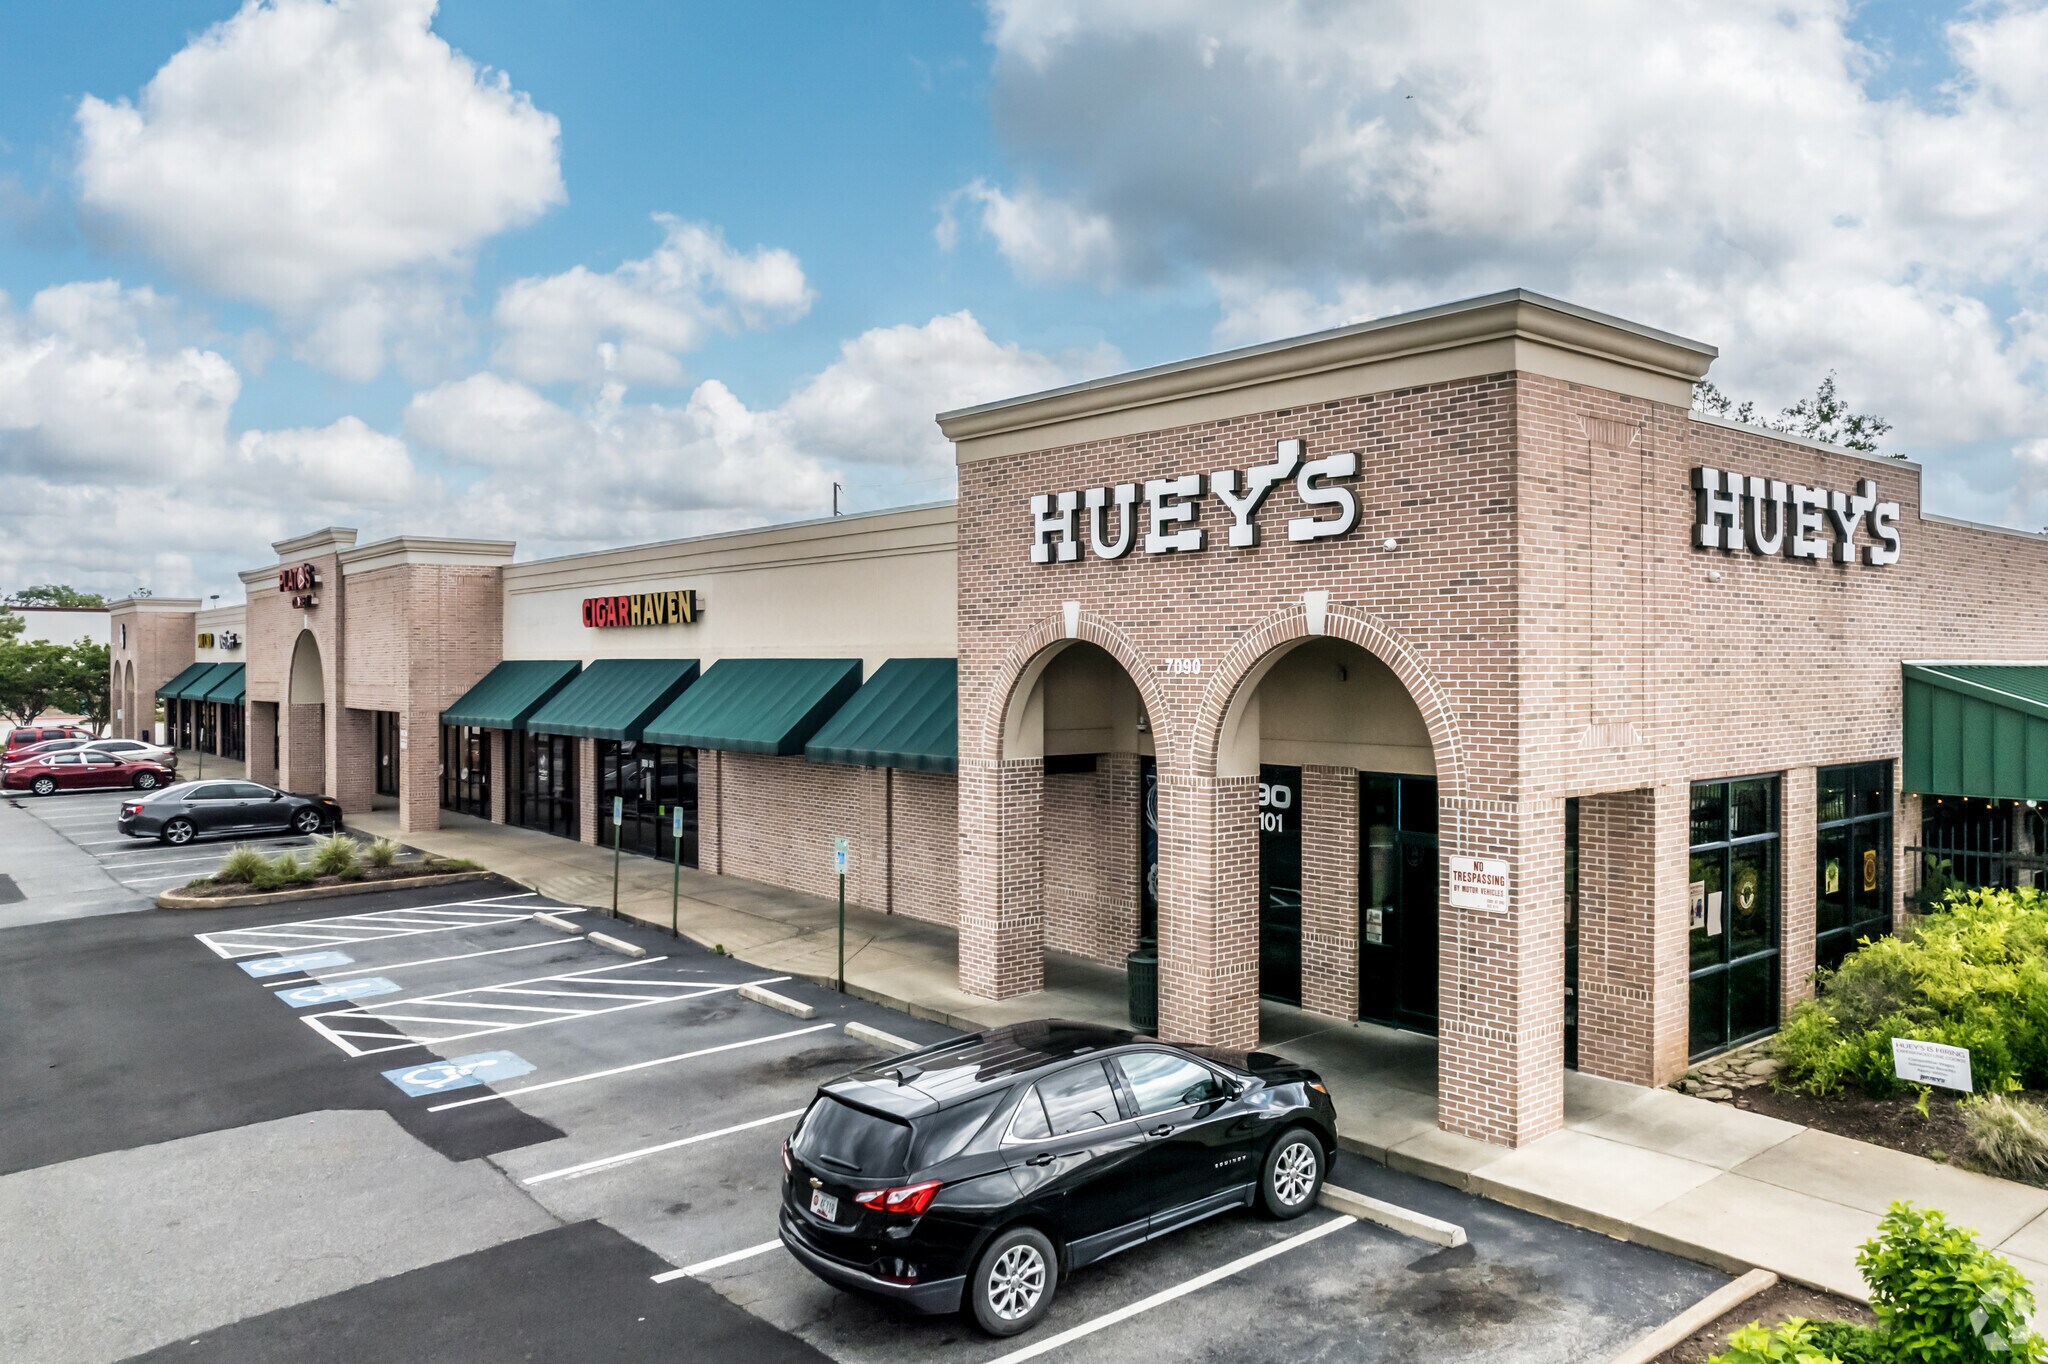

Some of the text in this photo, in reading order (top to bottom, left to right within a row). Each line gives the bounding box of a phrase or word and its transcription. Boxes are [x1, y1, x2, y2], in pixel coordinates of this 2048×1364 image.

[1030, 439, 1362, 563] HUEY'S
[1697, 467, 1900, 566] HUEY'S
[1165, 658, 1201, 674] 7090
[1473, 861, 1484, 872] NO
[1453, 870, 1505, 887] TRESPASSING
[1454, 884, 1504, 898] BY MOTOR VEHICLES
[1895, 1042, 1925, 1051] HUEY'S
[1935, 1047, 1965, 1058] HIRING
